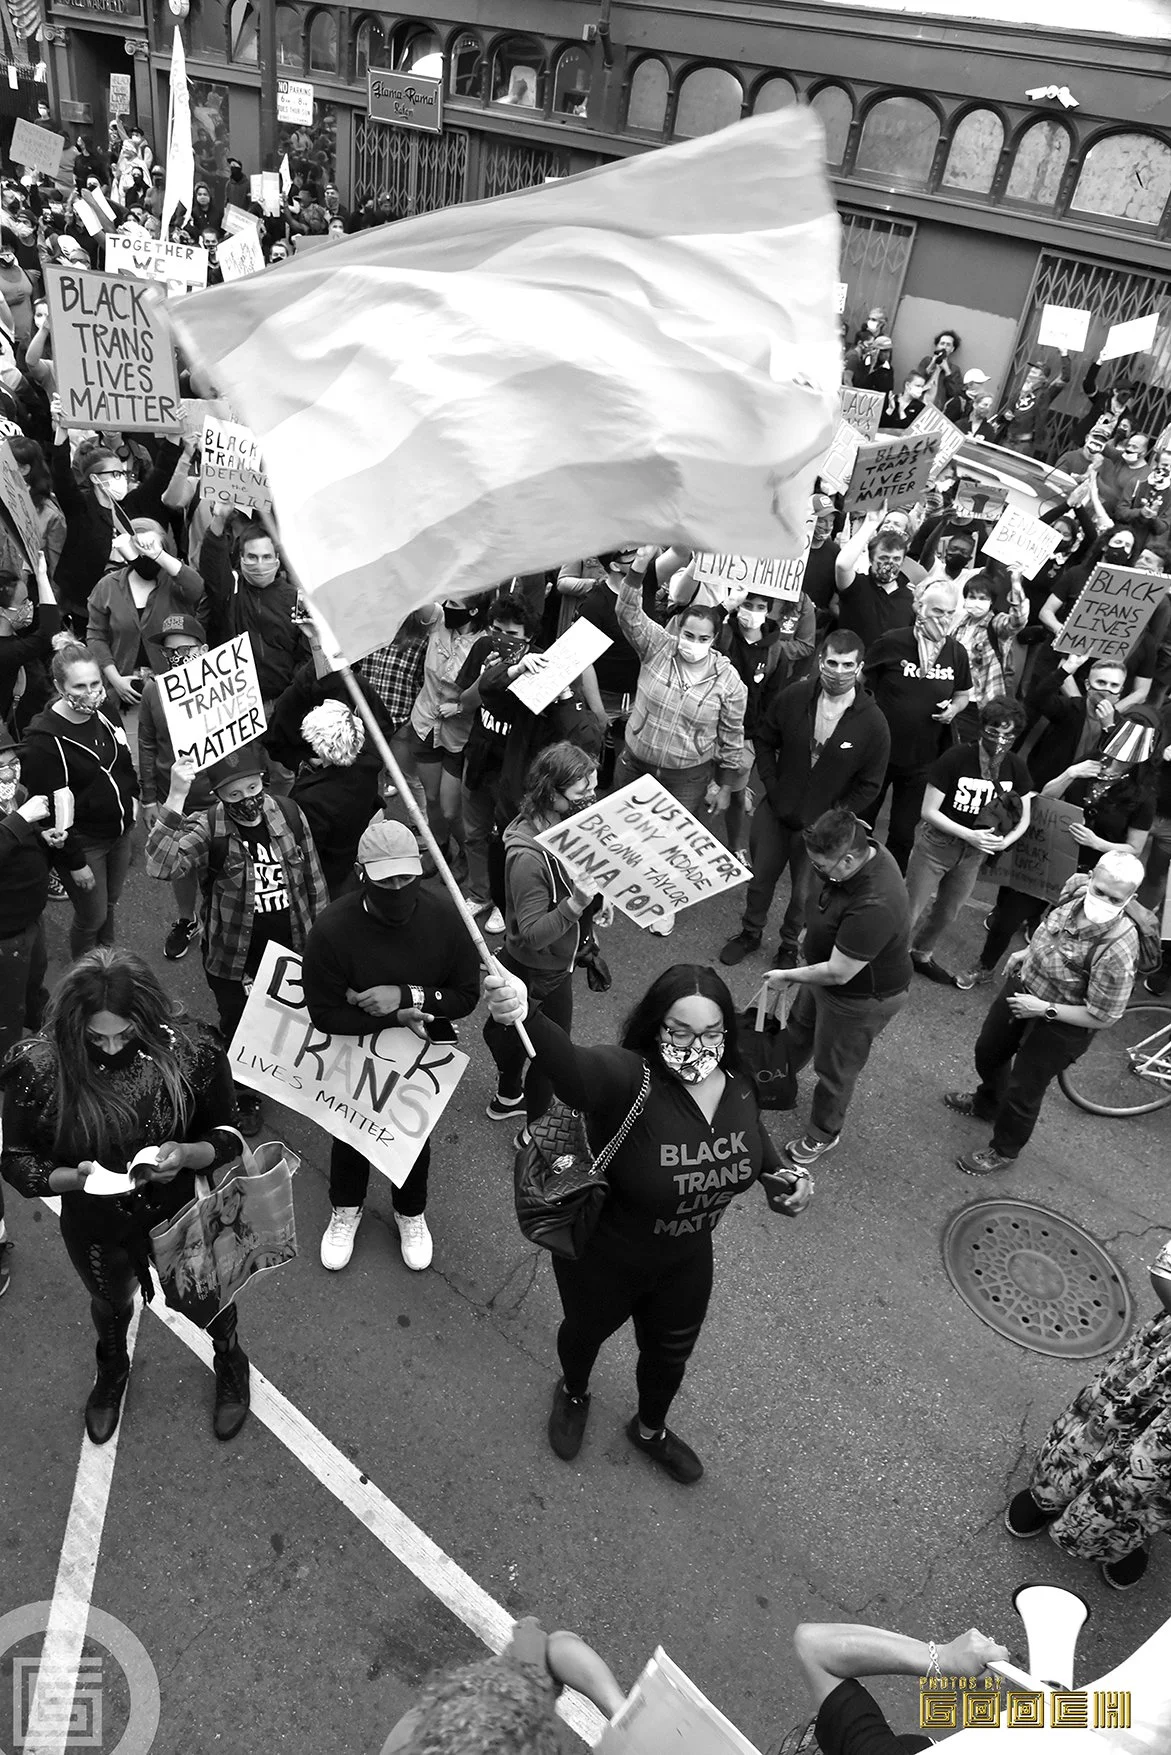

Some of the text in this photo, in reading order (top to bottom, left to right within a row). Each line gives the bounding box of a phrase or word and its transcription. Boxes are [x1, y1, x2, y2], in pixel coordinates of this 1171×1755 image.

[278, 81, 311, 96] NO PARKING
[109, 237, 194, 261] TOGETHER
[133, 255, 165, 273] WE
[59, 276, 151, 328] BLACK
[72, 323, 154, 364] TRANS
[82, 357, 153, 393] LIVES
[70, 387, 177, 423] MATTER
[205, 429, 258, 457] BLACK
[876, 437, 937, 463] BLACK
[860, 467, 917, 490] LIVES
[865, 454, 918, 475] TRANS
[855, 481, 915, 503] MATTER
[699, 553, 804, 592] LIVES MATTER
[1090, 570, 1164, 604] BLACK
[1073, 614, 1136, 638] LIVES
[1085, 600, 1144, 623] TRANS
[1059, 632, 1129, 657] MATTER
[163, 638, 248, 702] BLACK
[178, 669, 247, 719] TRANS
[204, 686, 257, 733] LIVES
[178, 707, 264, 767] MATTER
[615, 800, 712, 890] TONY MCDADE
[631, 791, 742, 883] JUSTICE FOR
[547, 828, 665, 918] NINA POP
[577, 813, 690, 908] BREONNA TAYLOR
[266, 956, 455, 1096] BCK
[264, 998, 433, 1140] TRANS
[236, 1046, 395, 1147] LIVES MATTER
[660, 1130, 749, 1167] BLACK
[673, 1158, 752, 1196] TRANS
[676, 1191, 735, 1215] LIVE
